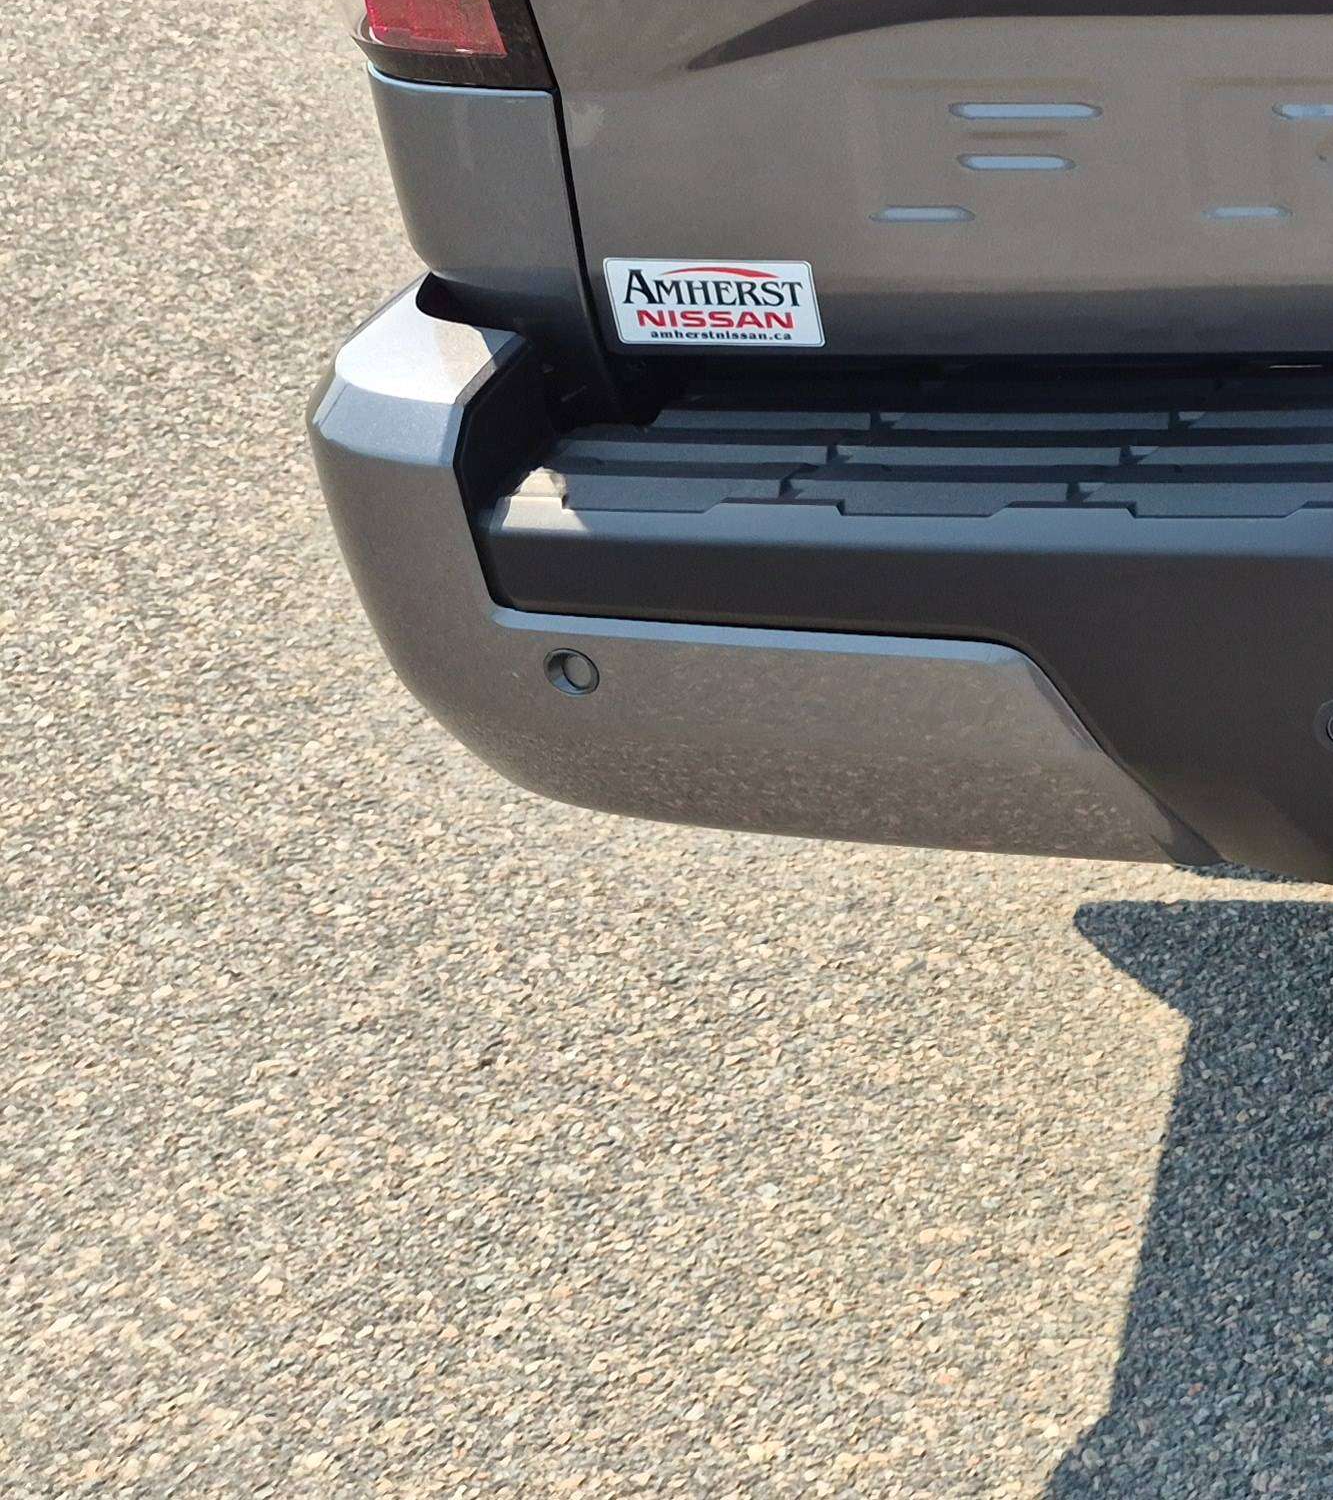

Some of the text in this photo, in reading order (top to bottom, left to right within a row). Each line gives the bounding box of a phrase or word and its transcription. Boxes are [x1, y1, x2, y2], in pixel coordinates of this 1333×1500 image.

[622, 269, 804, 307] AMHERST
[636, 310, 794, 329] NISSAN
[651, 330, 792, 341] amherstnissan.ca
